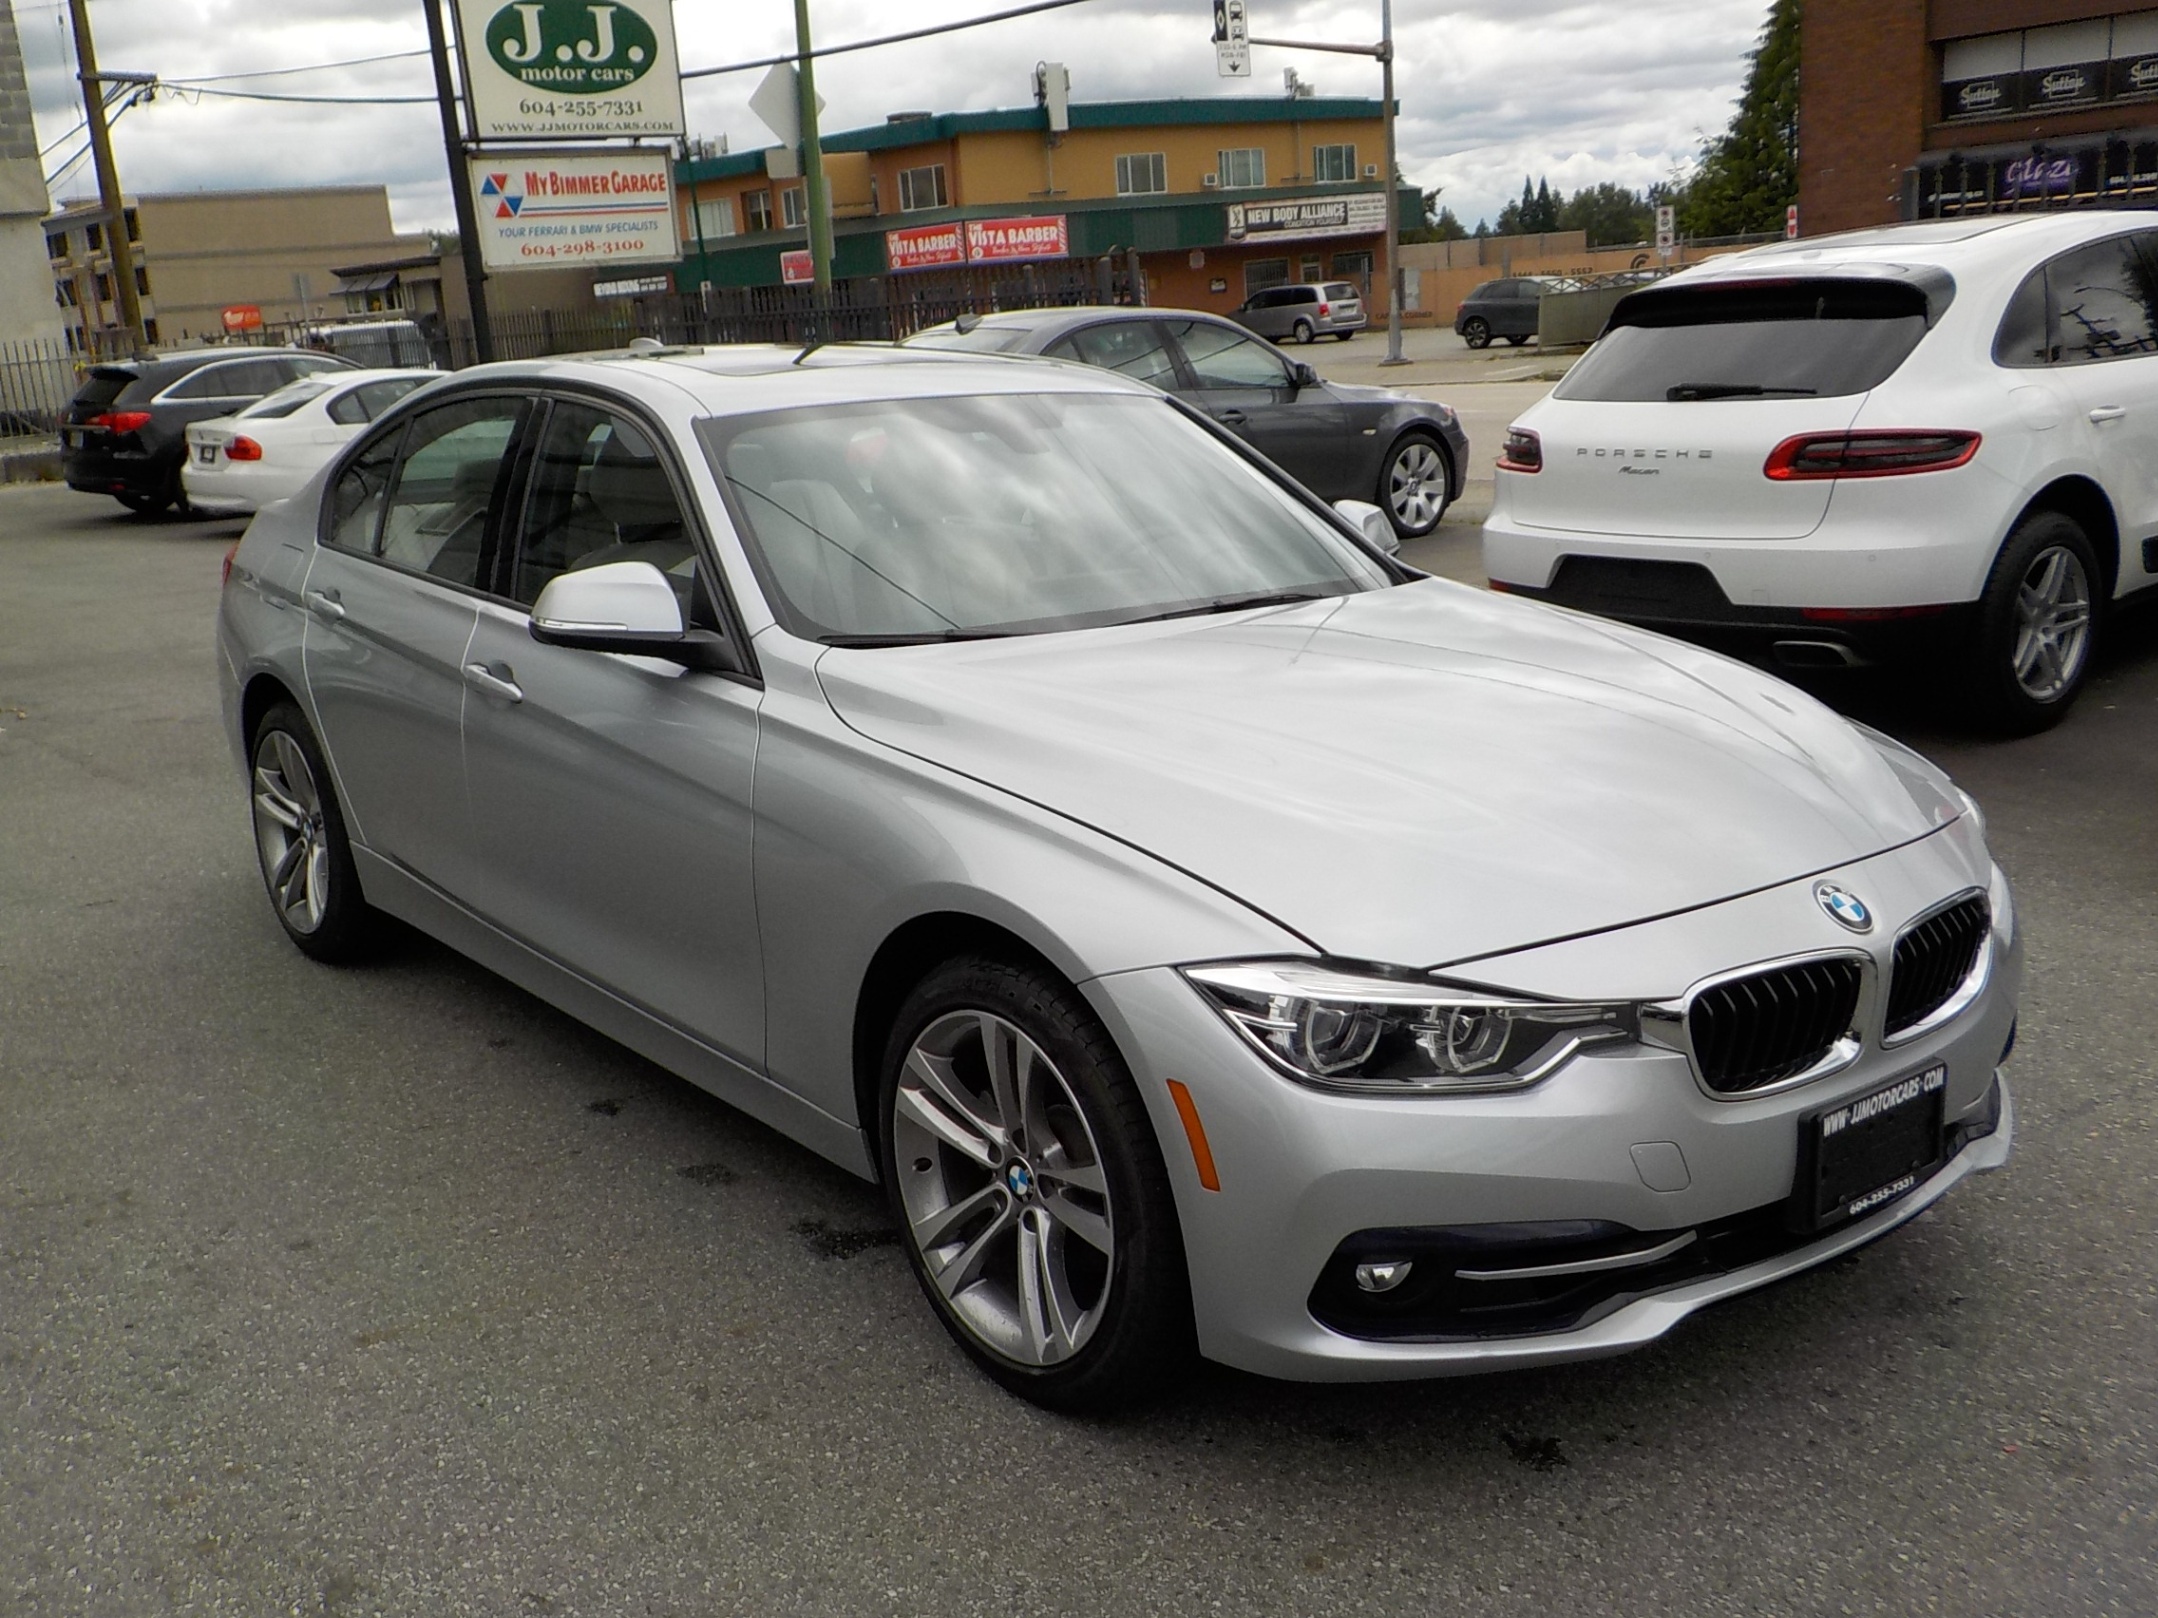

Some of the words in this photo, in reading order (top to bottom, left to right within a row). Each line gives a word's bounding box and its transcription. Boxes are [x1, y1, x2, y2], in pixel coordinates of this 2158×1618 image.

[502, 4, 645, 62] J.J.
[520, 66, 586, 81] motor
[591, 68, 635, 81] cars
[1961, 84, 2001, 104] Sutton
[2041, 76, 2086, 94] Sutton
[519, 98, 644, 117] 604-255-7331
[491, 121, 674, 132] WWW.JJMOTORCARS.COM
[1247, 207, 1271, 224] NEW
[1272, 205, 1299, 222] BODY
[1300, 202, 1346, 220] ALLIANCE
[499, 227, 526, 238] YOUR
[528, 225, 568, 237] FERRARI
[570, 226, 577, 235] &
[579, 224, 603, 235] BMW
[605, 220, 659, 233] SPECIALISTS
[968, 229, 1007, 247] VISTA
[1008, 225, 1059, 244] BARBER
[520, 239, 644, 257] 604-298-3100
[889, 238, 917, 256] VISTA
[917, 232, 957, 253] BARBER
[1576, 447, 1713, 459] PORSCHE
[1618, 464, 1660, 476] Macan
[1849, 1175, 1915, 1215] 604-255-7331
